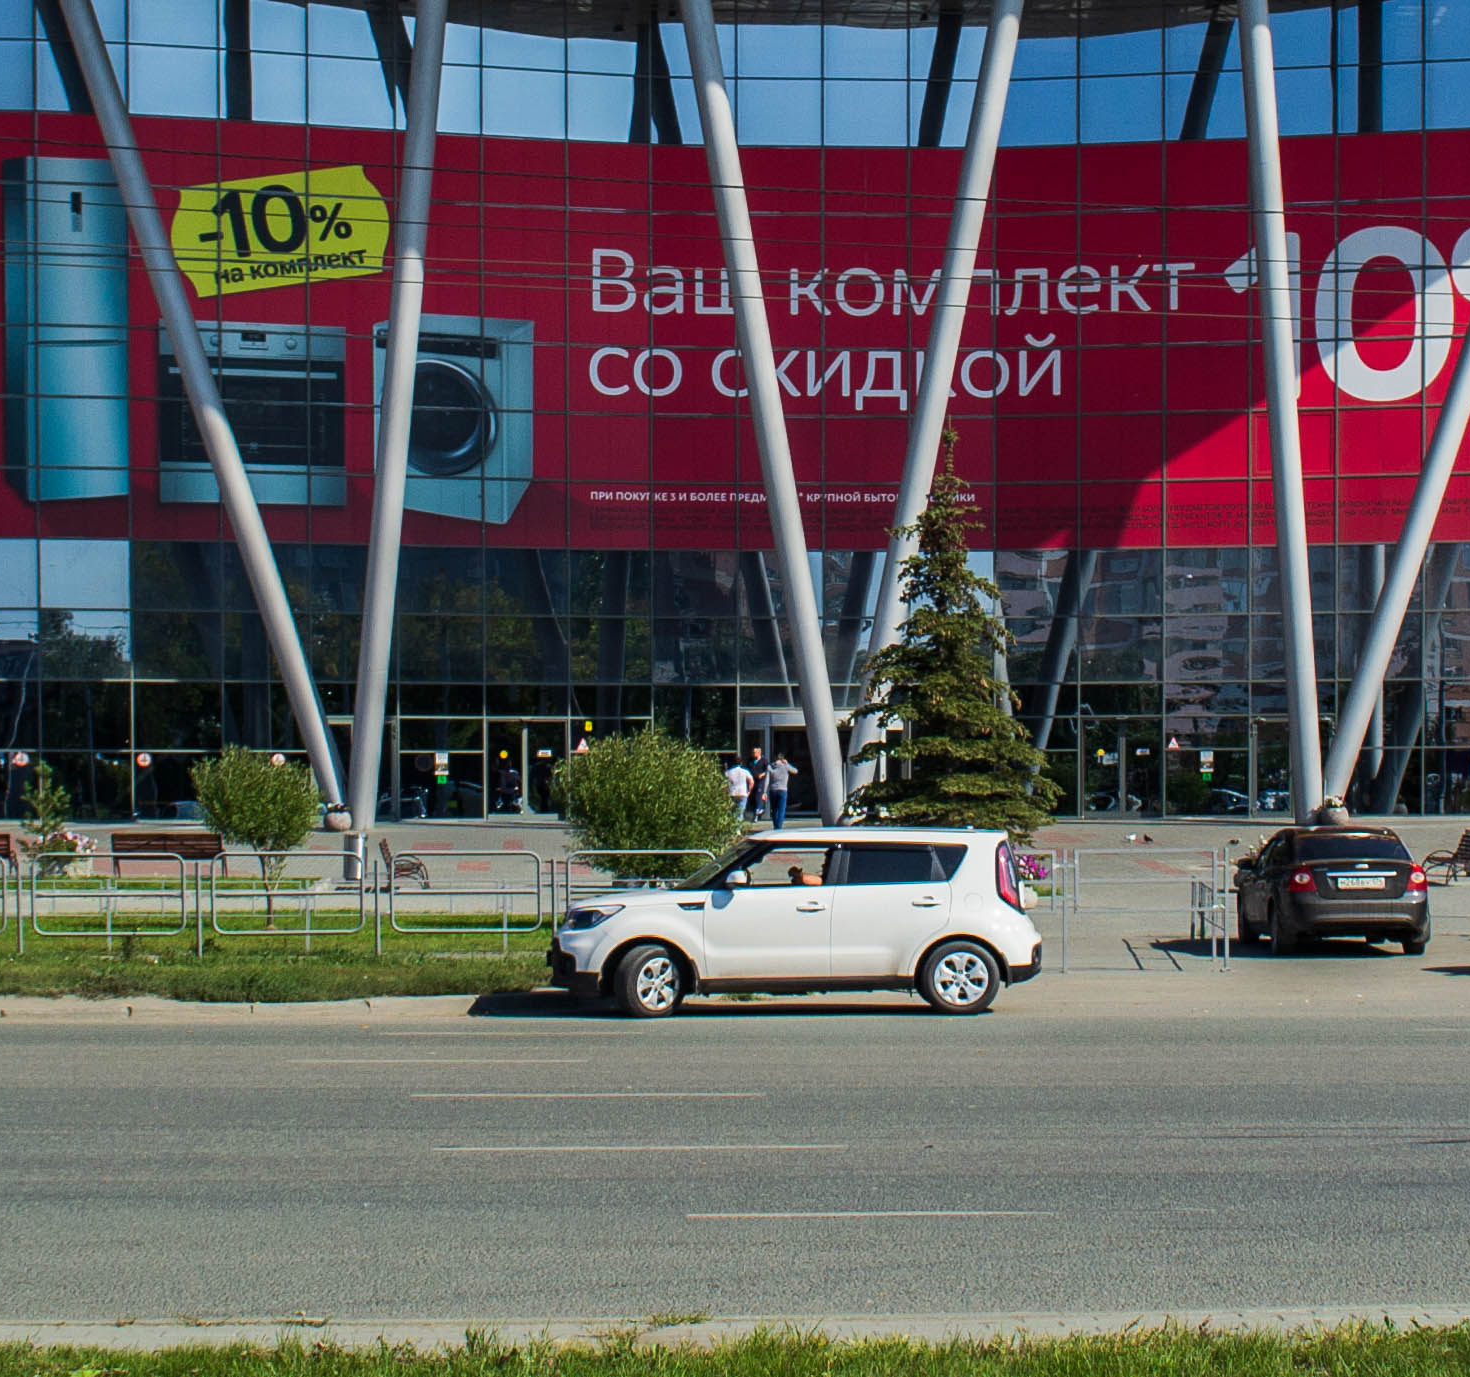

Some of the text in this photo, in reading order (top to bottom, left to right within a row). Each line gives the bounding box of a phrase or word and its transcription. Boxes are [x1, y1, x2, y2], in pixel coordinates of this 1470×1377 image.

[250, 249, 367, 279] комплект
[589, 346, 682, 397] со
[590, 491, 613, 501] ПРИ
[690, 492, 727, 502] БОЛЕЕ
